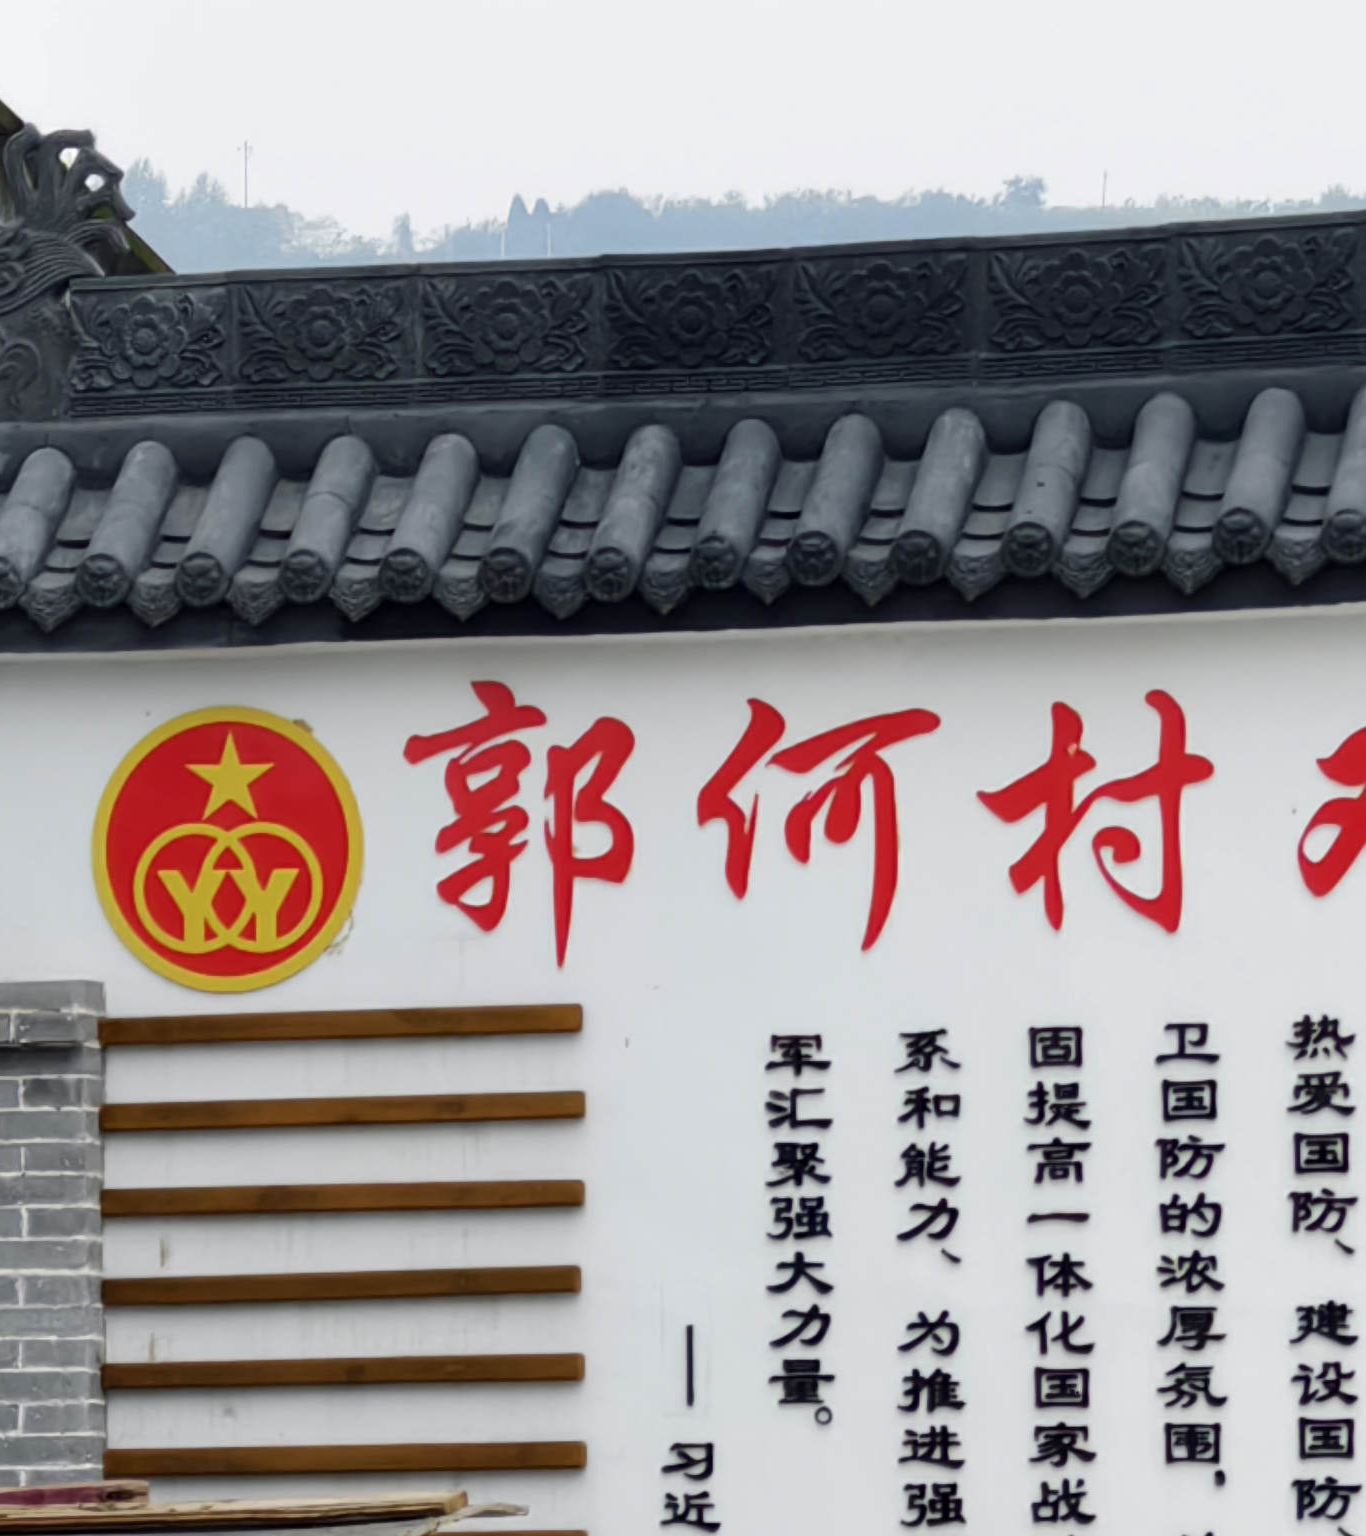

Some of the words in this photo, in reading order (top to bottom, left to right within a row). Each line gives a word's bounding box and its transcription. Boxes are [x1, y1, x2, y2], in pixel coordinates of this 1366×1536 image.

[764, 1034, 836, 1426] 军汇聚强大力量。
